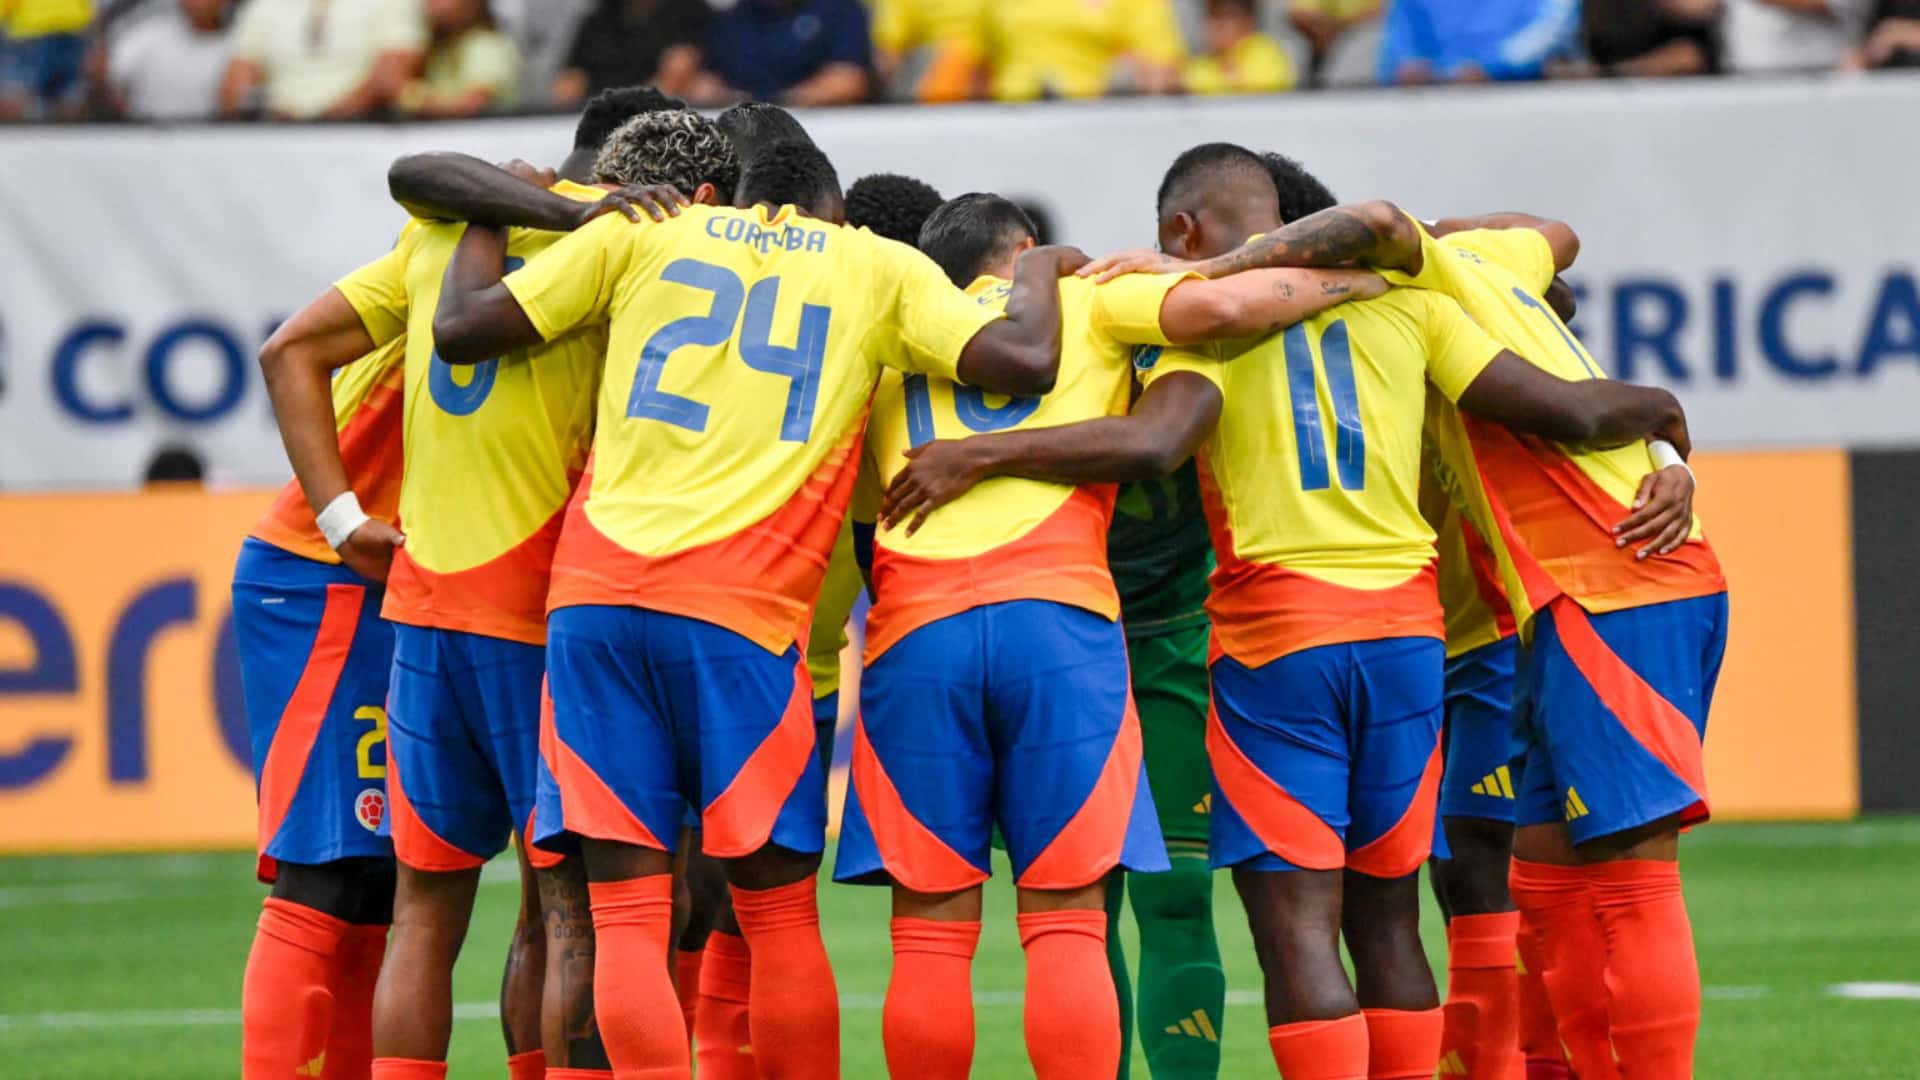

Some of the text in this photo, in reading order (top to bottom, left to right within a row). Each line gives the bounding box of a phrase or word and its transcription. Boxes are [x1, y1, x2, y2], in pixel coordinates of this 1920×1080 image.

[51, 319, 283, 426] CO
[626, 258, 831, 443] 24
[1284, 319, 1365, 491] 11
